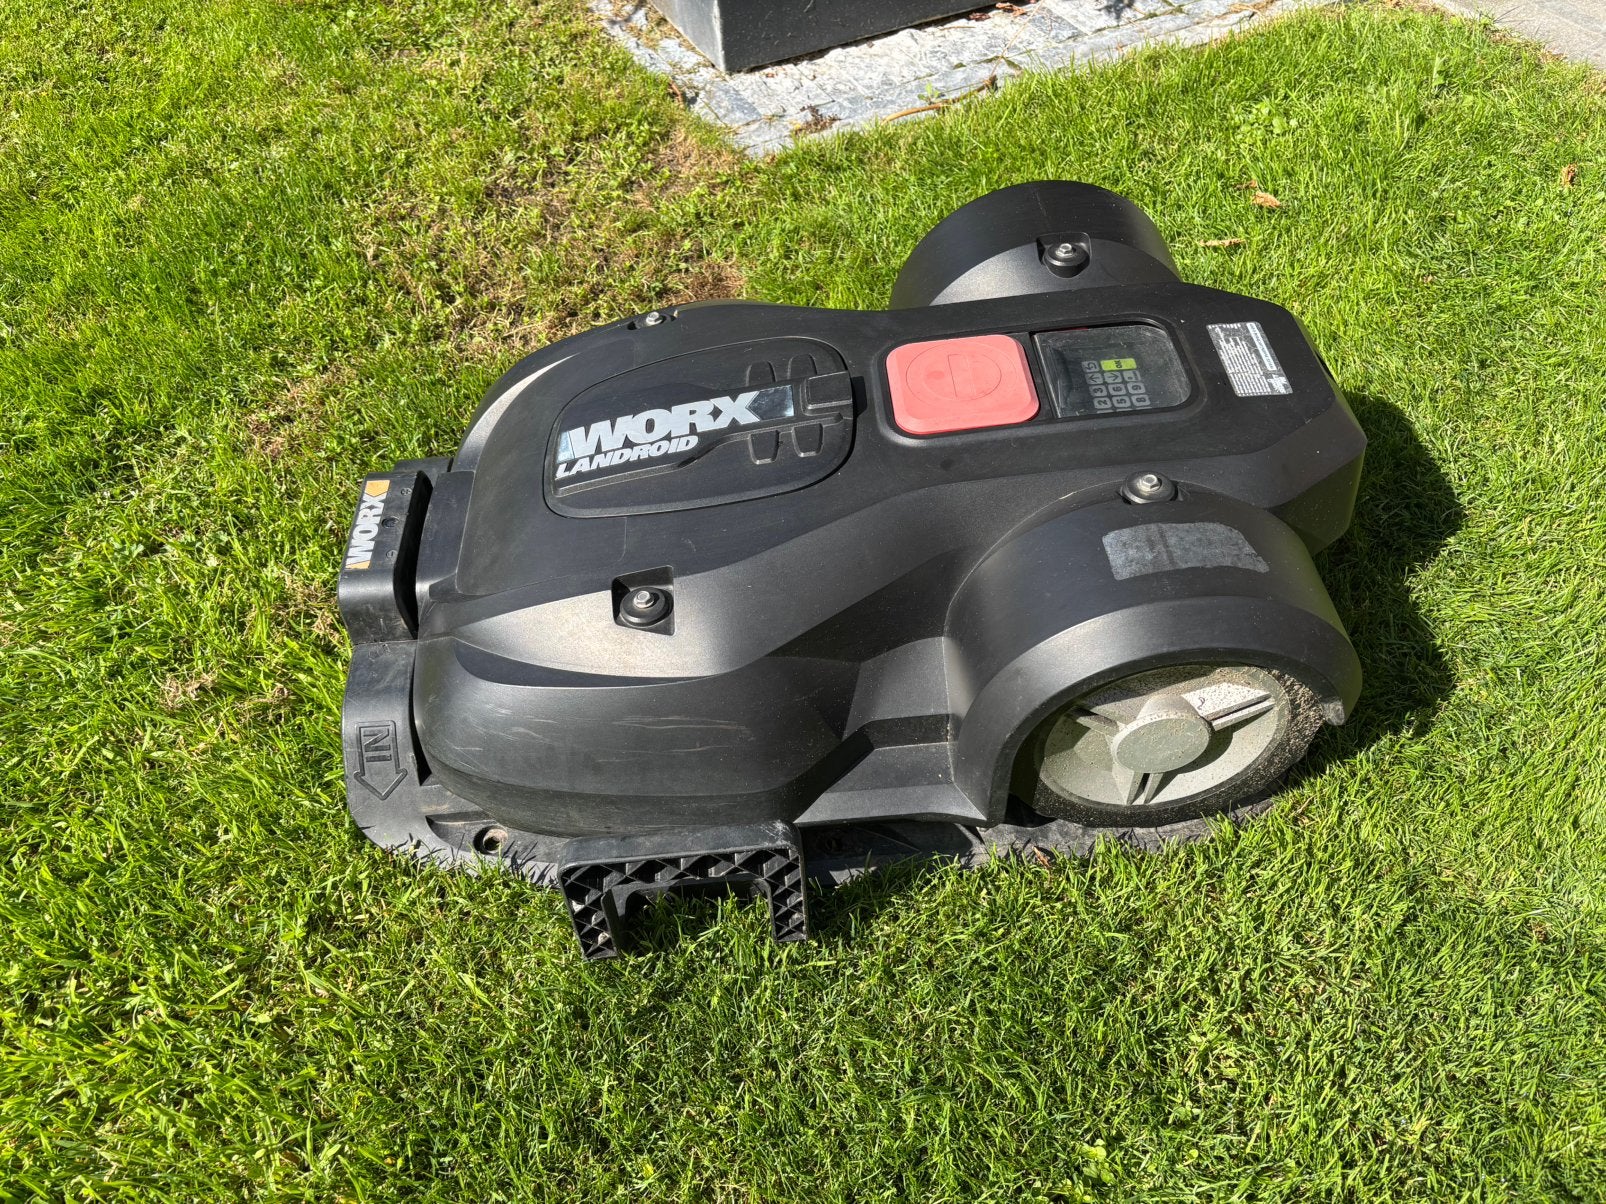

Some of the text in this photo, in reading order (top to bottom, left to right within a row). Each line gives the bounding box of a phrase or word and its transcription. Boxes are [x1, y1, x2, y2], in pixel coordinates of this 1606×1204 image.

[1114, 360, 1123, 369] OK
[568, 391, 760, 459] WORX
[556, 435, 699, 478] LANDROID
[345, 492, 388, 566] WORX
[363, 728, 392, 763] IN
